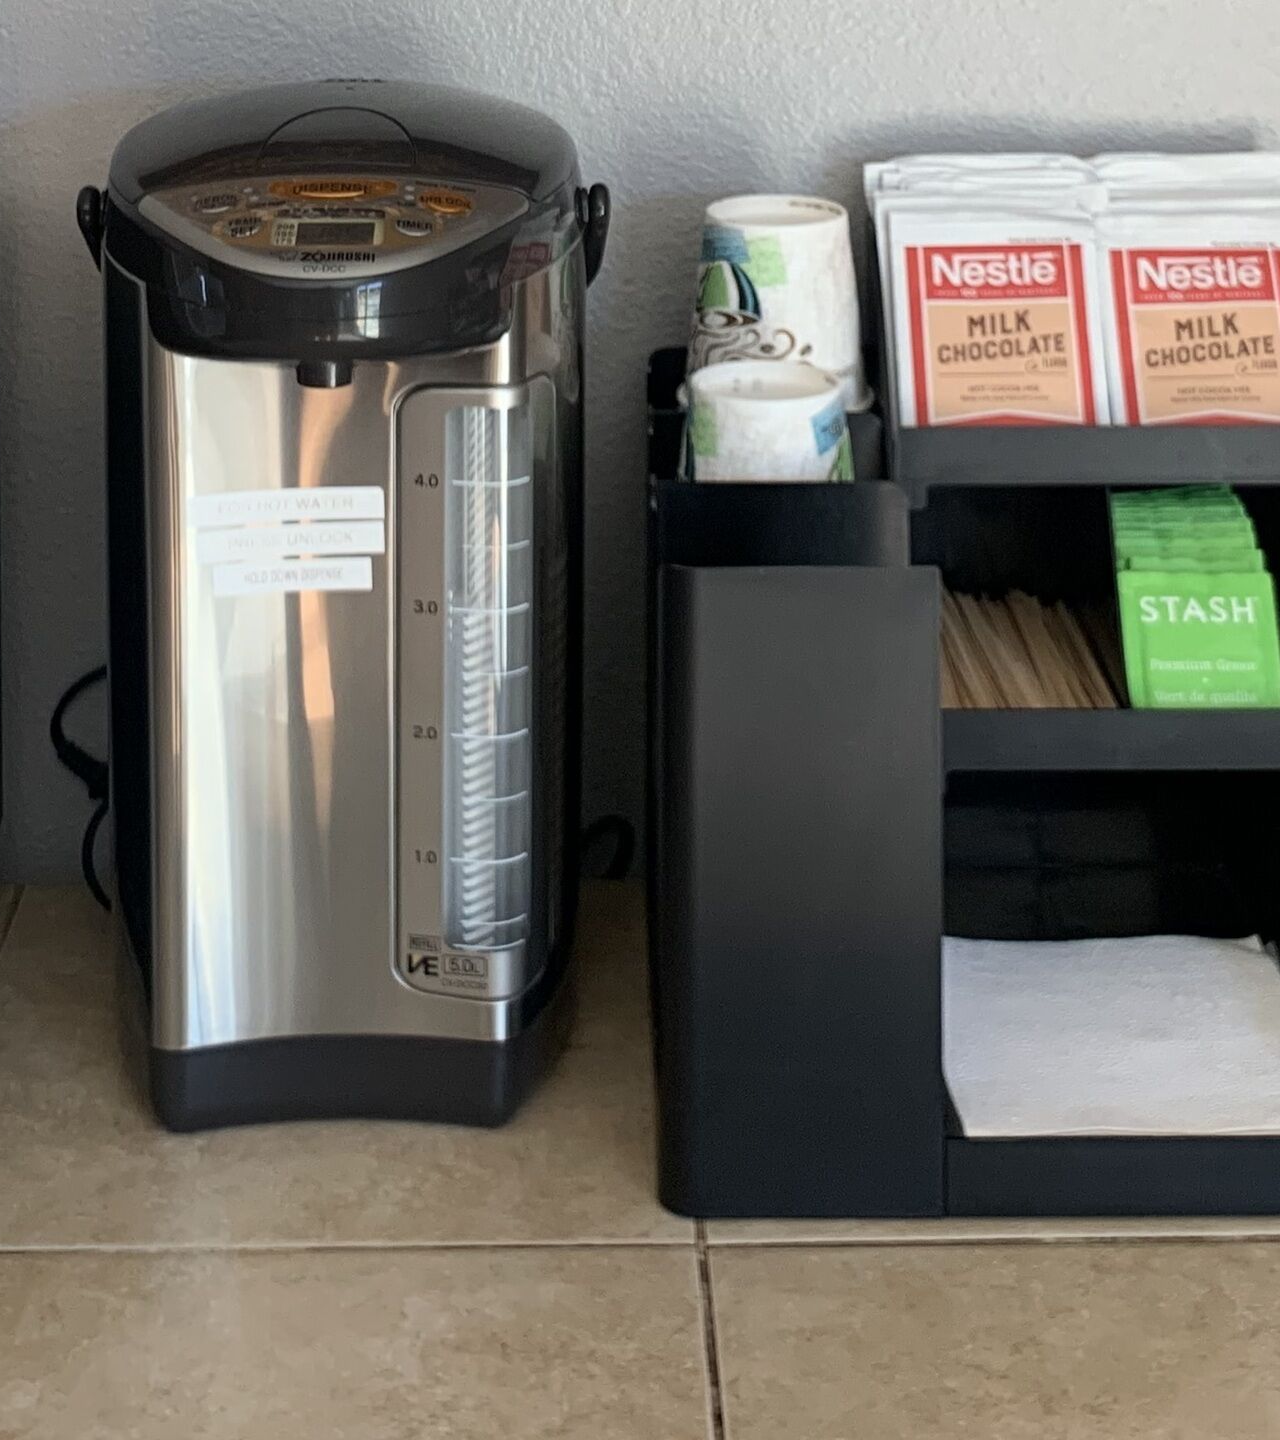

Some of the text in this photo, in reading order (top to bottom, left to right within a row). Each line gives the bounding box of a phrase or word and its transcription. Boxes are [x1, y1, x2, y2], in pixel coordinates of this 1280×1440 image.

[396, 220, 433, 231] TIMER
[300, 250, 375, 262] ZOJIRUSHI
[967, 310, 1031, 337] MILK
[1174, 313, 1239, 341] MILK
[937, 333, 1065, 364] CHOCOLATE
[1145, 335, 1275, 368] CHOCOLATE
[414, 474, 438, 488] 4.0
[295, 496, 354, 510] WATER
[413, 600, 438, 615] 3.0
[1140, 596, 1256, 623] STASH
[413, 725, 437, 740] 2.0
[415, 850, 438, 865] 1.0
